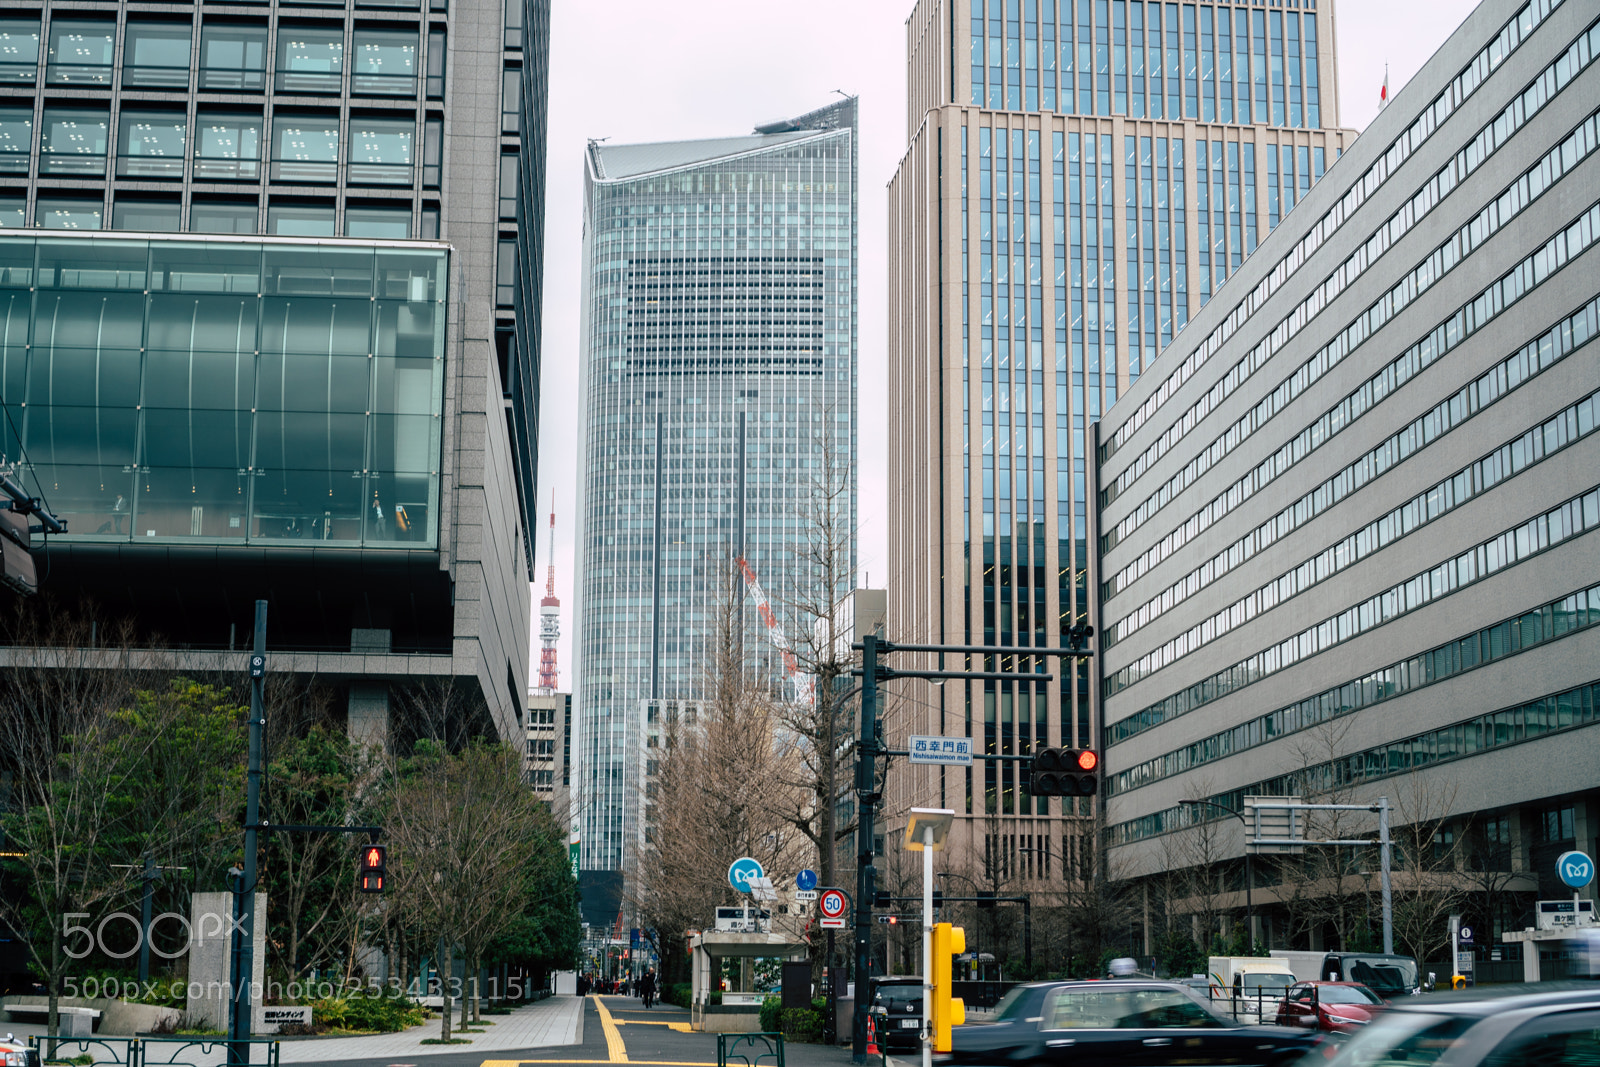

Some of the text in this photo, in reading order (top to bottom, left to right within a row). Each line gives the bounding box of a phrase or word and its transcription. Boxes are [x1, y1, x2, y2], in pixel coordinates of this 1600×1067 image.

[915, 740, 968, 753] 西幸門前
[913, 752, 955, 760] Nishisaiwaimon
[826, 898, 840, 910] 50
